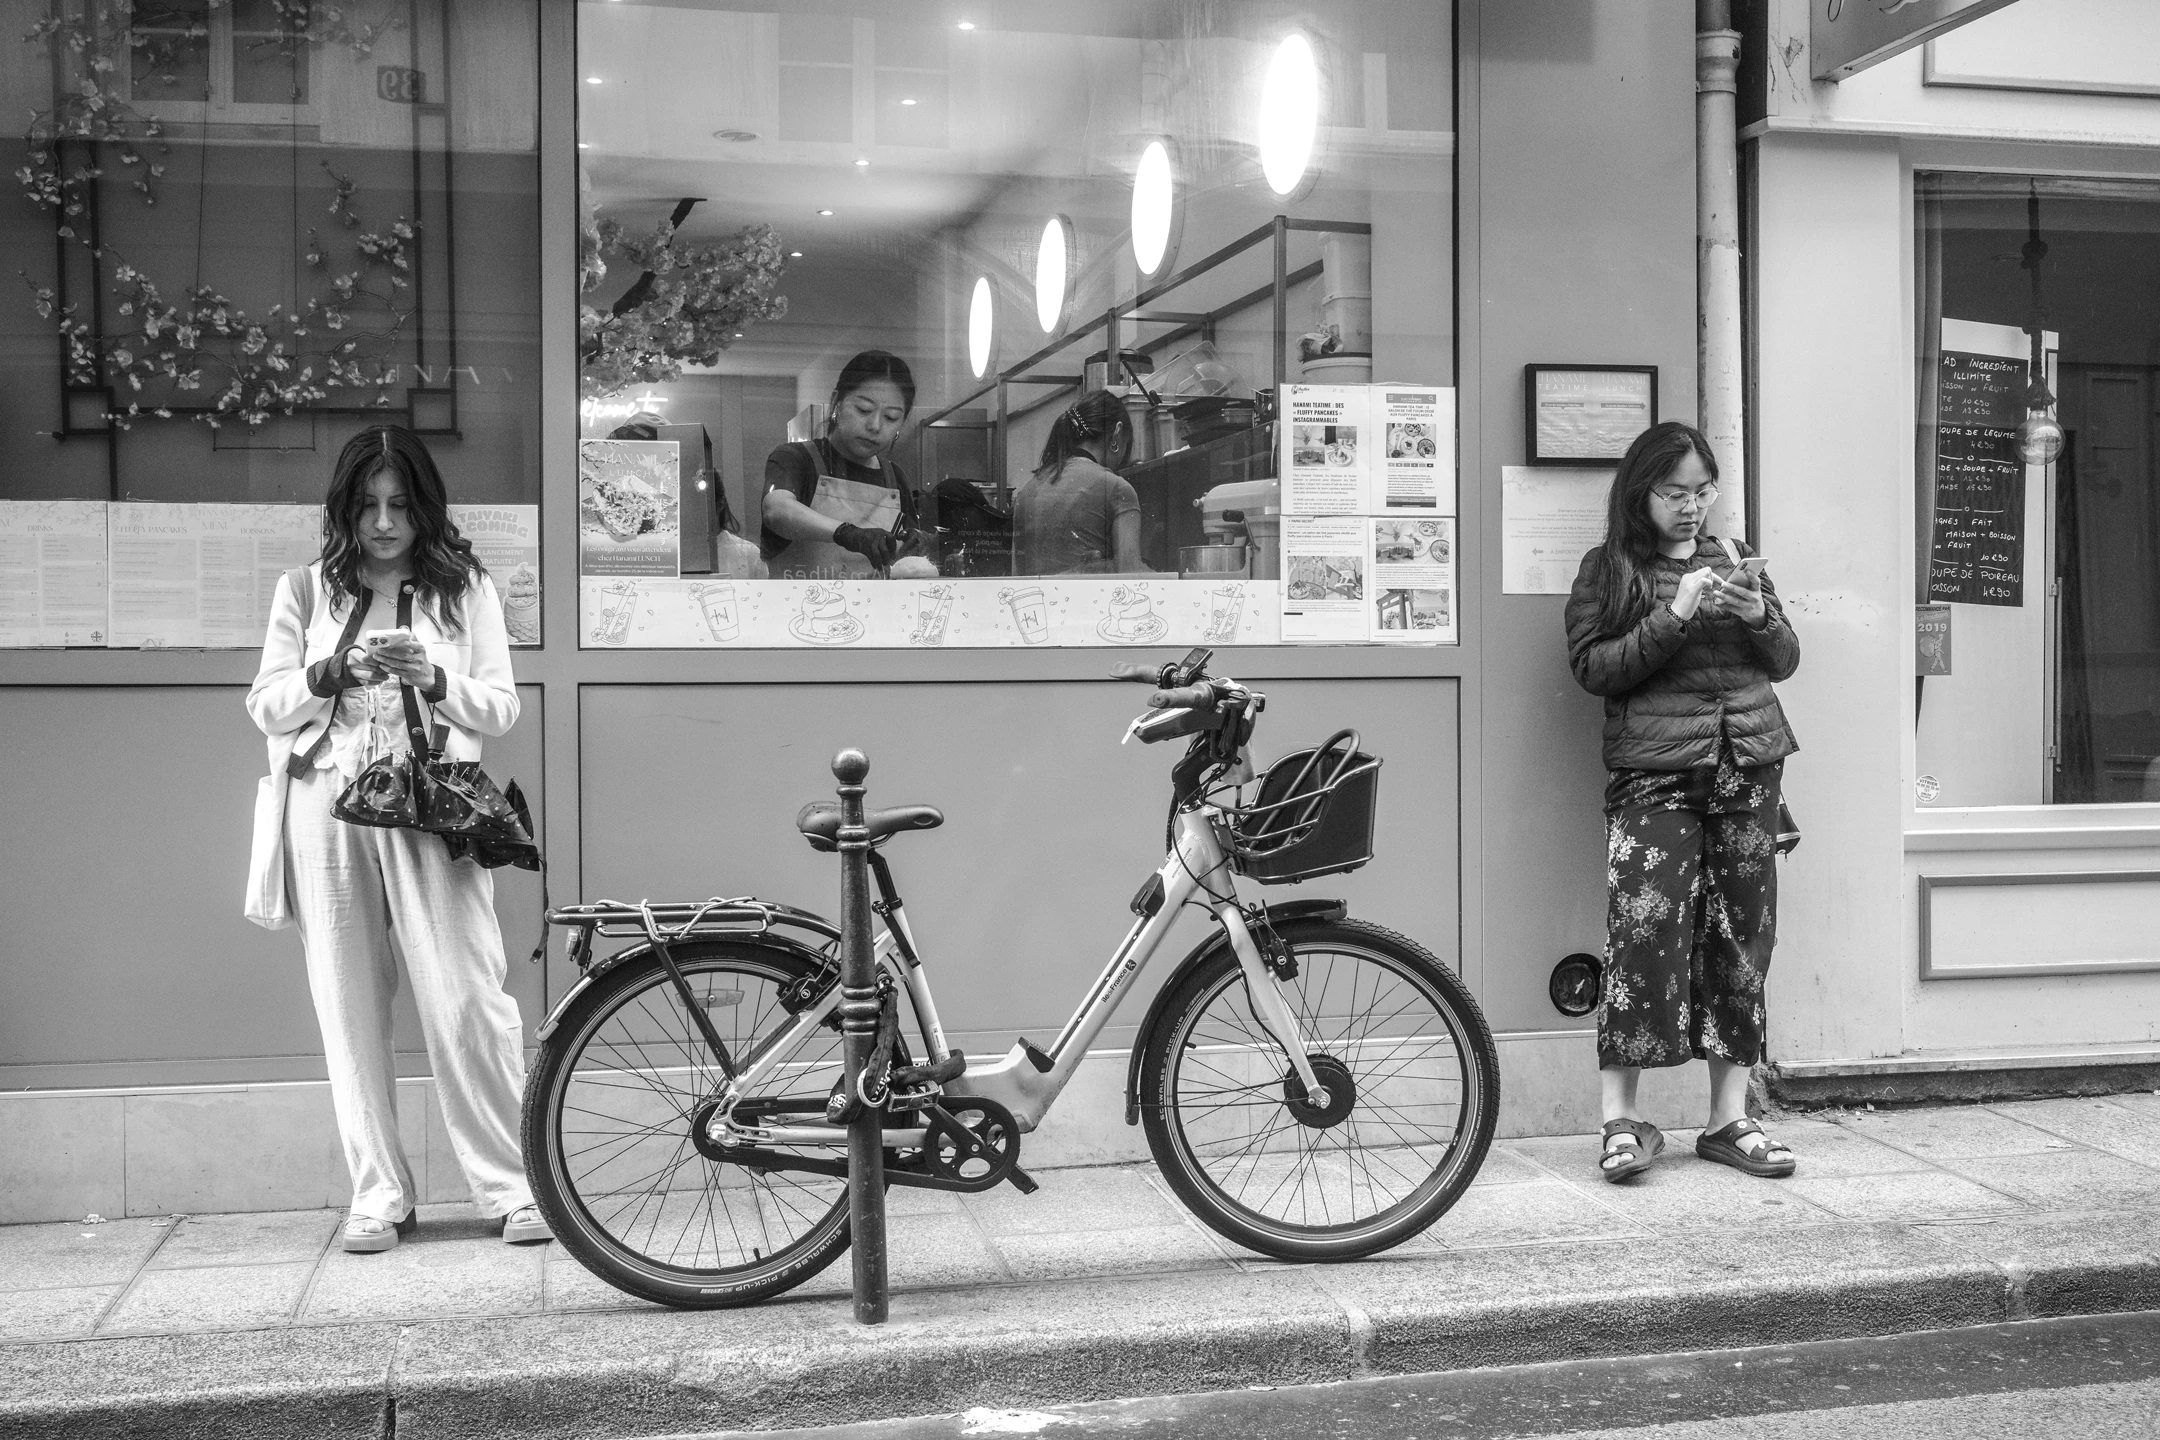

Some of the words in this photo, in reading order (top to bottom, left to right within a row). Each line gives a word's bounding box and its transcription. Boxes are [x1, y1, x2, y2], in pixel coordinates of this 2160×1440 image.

[1941, 356, 1957, 367] AD
[1968, 358, 2019, 374] INGREDIENT
[581, 395, 640, 427] elcome
[1983, 428, 2016, 439] LEGUME
[609, 469, 651, 477] LUNCH
[1962, 464, 1987, 473] SOUPE
[1996, 466, 2019, 475] FRUIT
[457, 510, 519, 523] TAIYAKI
[1971, 518, 1993, 527] FAIT
[148, 526, 188, 534] PANCAKES
[240, 527, 276, 535] BOISSONS
[465, 520, 529, 539] COMING
[1945, 530, 1977, 539] MAISON
[1988, 531, 2016, 541] BOISSON
[1960, 569, 1974, 579] DE
[1980, 571, 2020, 583] POIREAU
[1917, 622, 1947, 632] 2019
[1919, 778, 1938, 787] VITRIER
[1165, 1015, 1184, 1054] PICK-UP
[794, 1228, 843, 1270] SCHWALBE
[735, 1275, 779, 1292] PICK-UP
